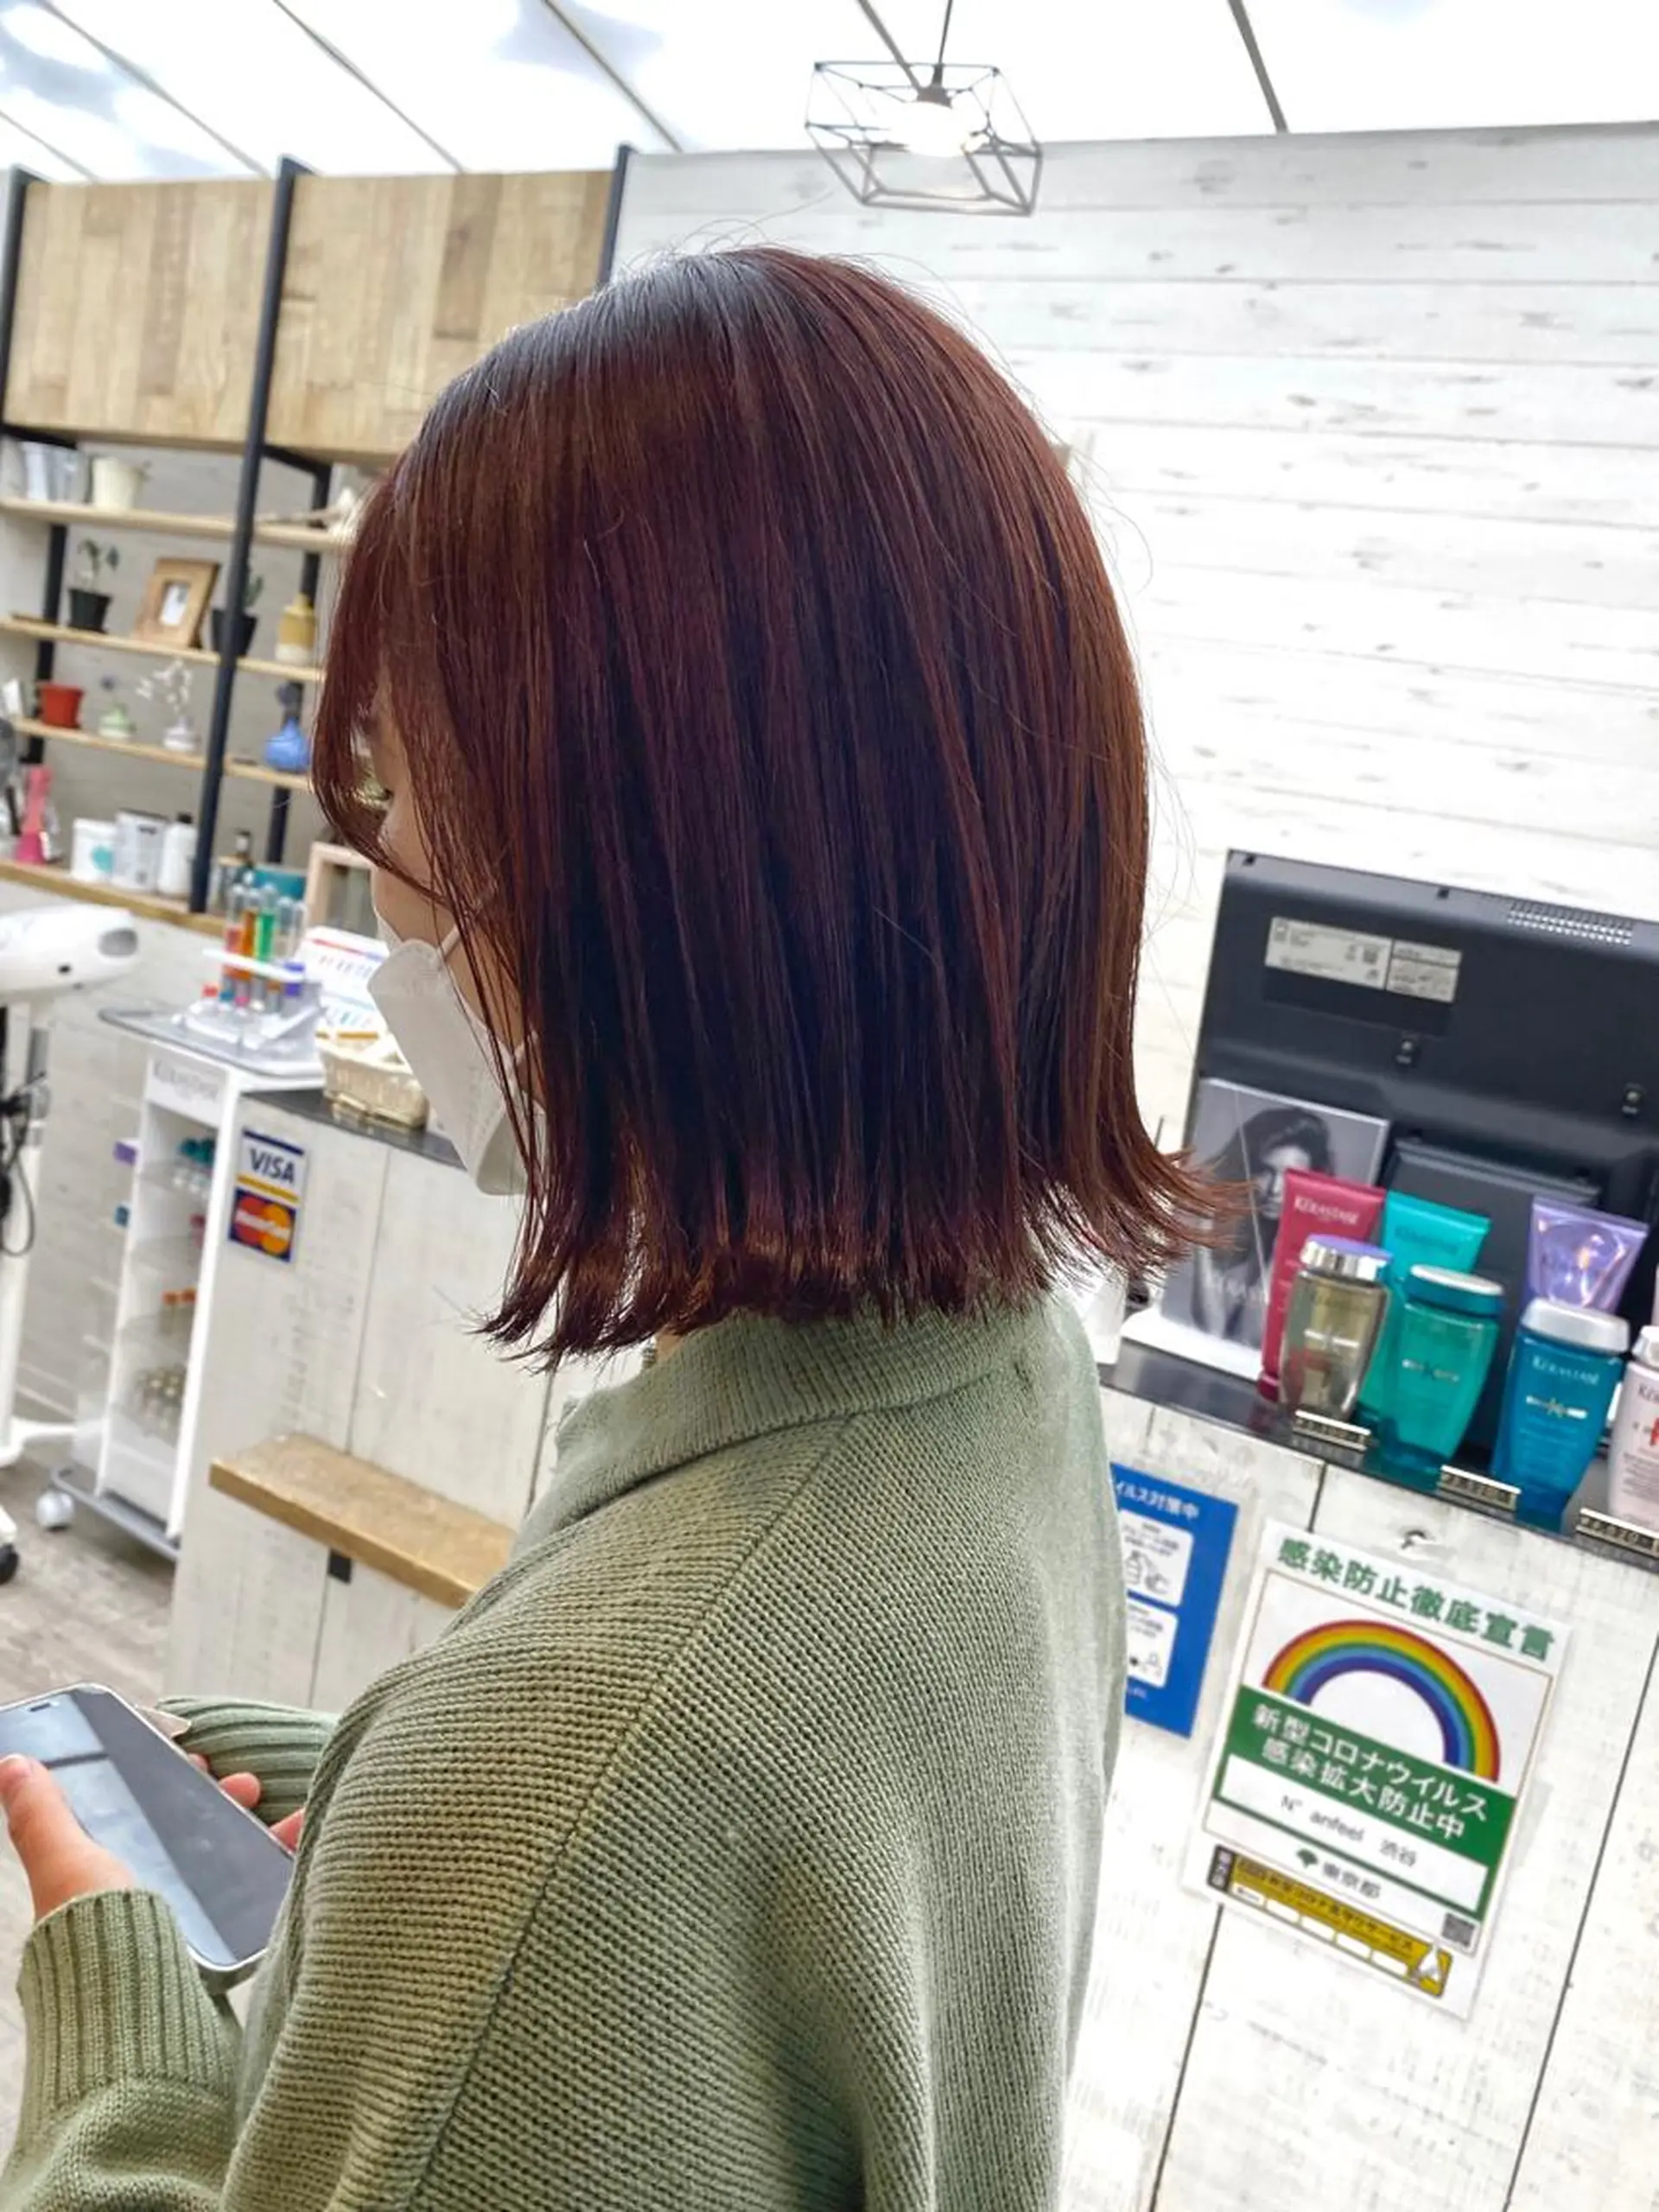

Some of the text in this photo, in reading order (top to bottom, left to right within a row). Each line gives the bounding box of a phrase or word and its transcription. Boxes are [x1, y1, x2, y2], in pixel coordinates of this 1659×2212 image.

[250, 1147, 295, 1184] VISA
[1277, 1538, 1554, 1662] 感染防止徹底宣言
[1253, 1704, 1487, 1822] 新型コロナウイルス
[1262, 1737, 1465, 1840] 感染拡大防止中
